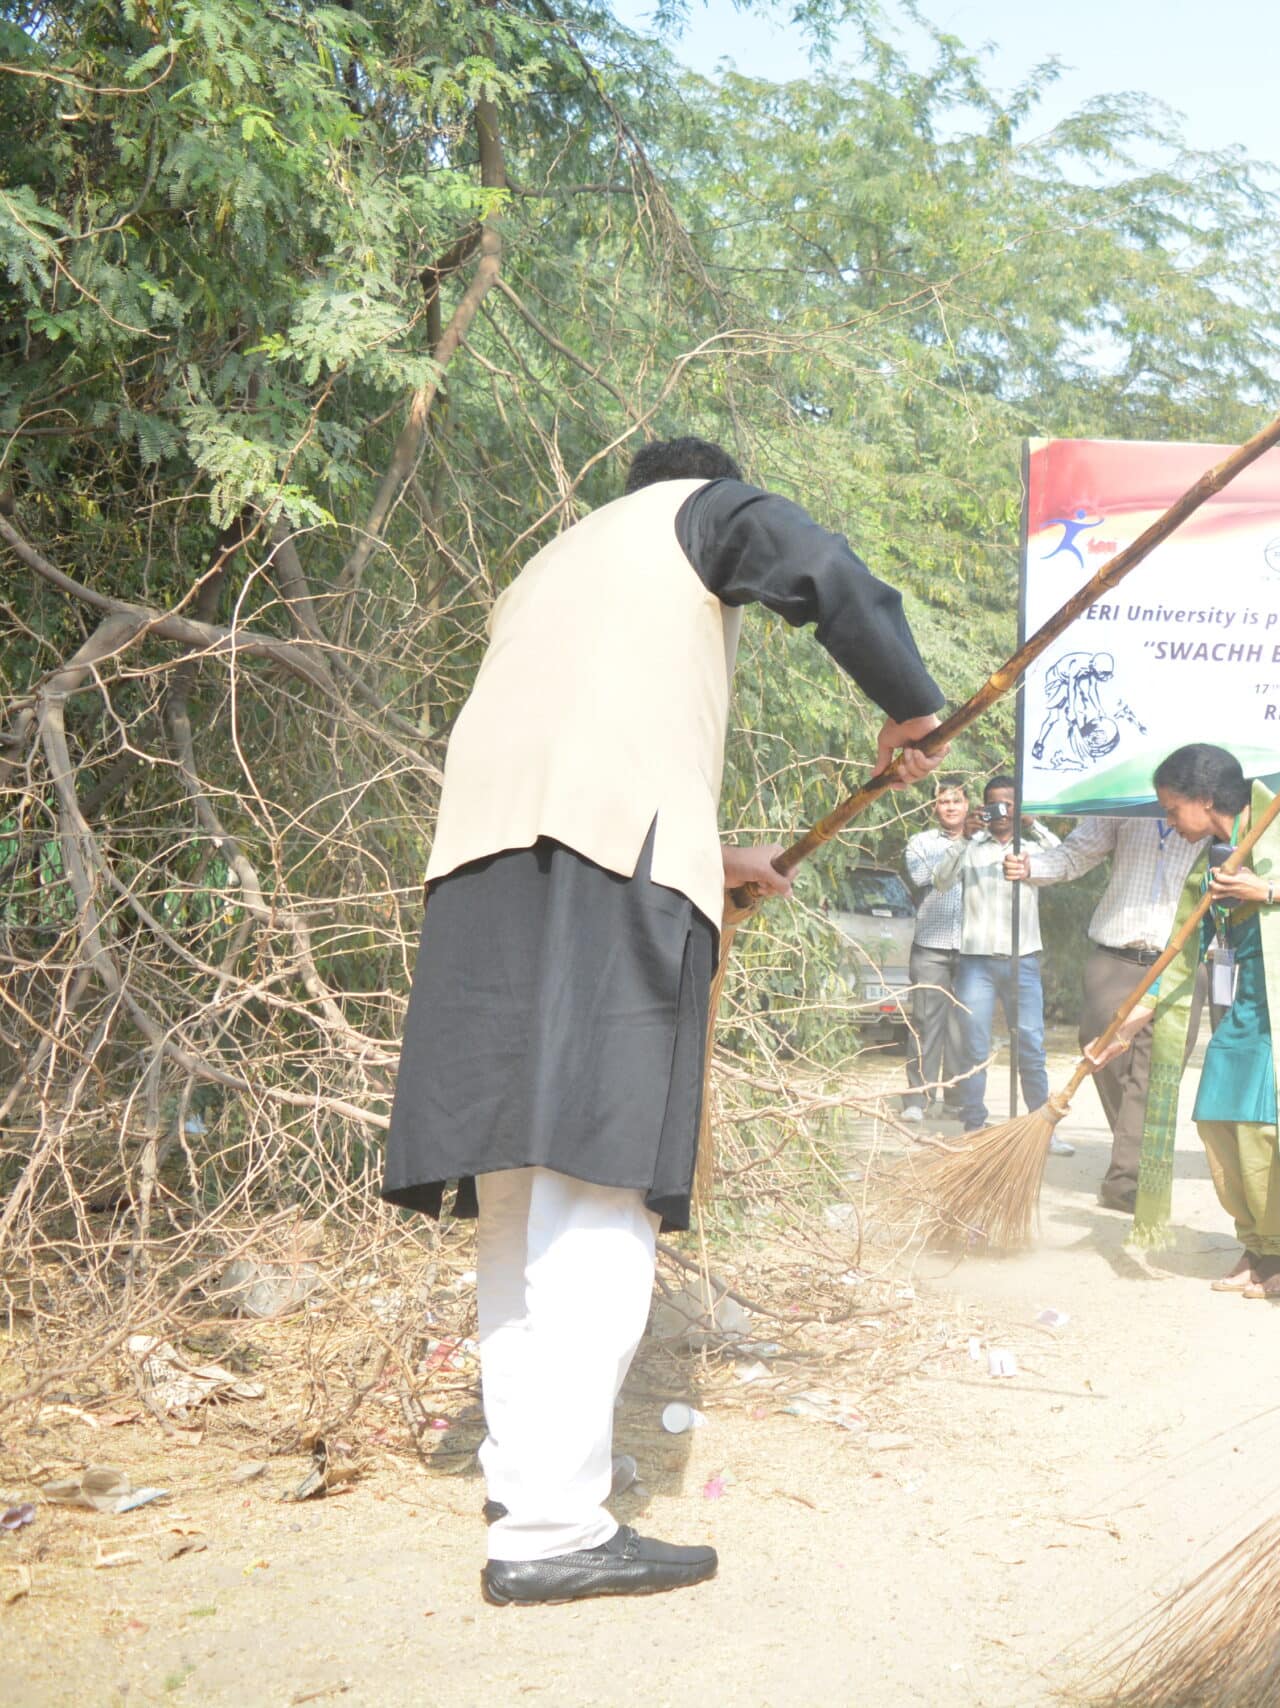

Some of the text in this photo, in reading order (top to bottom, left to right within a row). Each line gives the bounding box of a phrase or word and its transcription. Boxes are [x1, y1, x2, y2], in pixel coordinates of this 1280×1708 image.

[1076, 603, 1120, 621] ERI
[1127, 604, 1237, 629] University
[1242, 607, 1259, 625] is
[1143, 640, 1264, 663] "SWACHH
